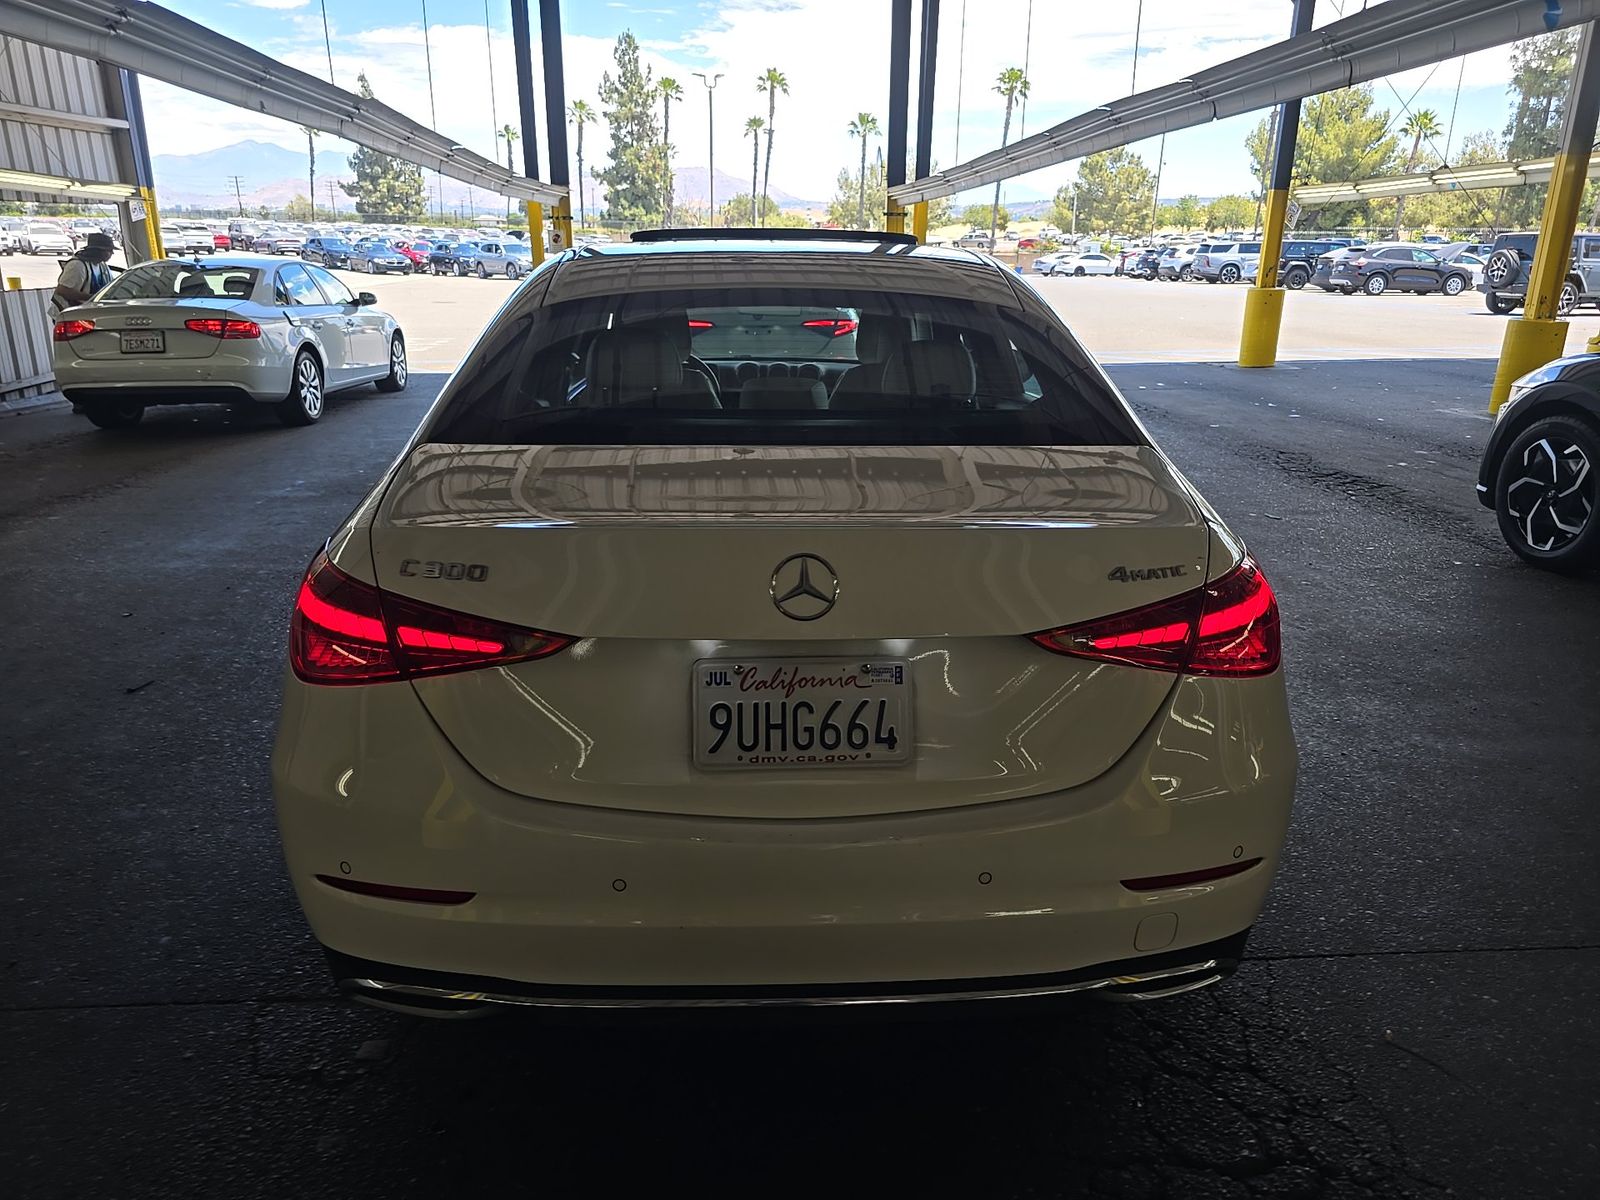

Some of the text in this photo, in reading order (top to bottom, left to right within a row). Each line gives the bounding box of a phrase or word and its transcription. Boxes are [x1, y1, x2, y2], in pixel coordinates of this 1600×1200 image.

[1107, 565, 1188, 583] 4MATIC
[705, 671, 732, 687] JUL
[739, 666, 872, 699] California
[708, 699, 898, 754] 9UHG664
